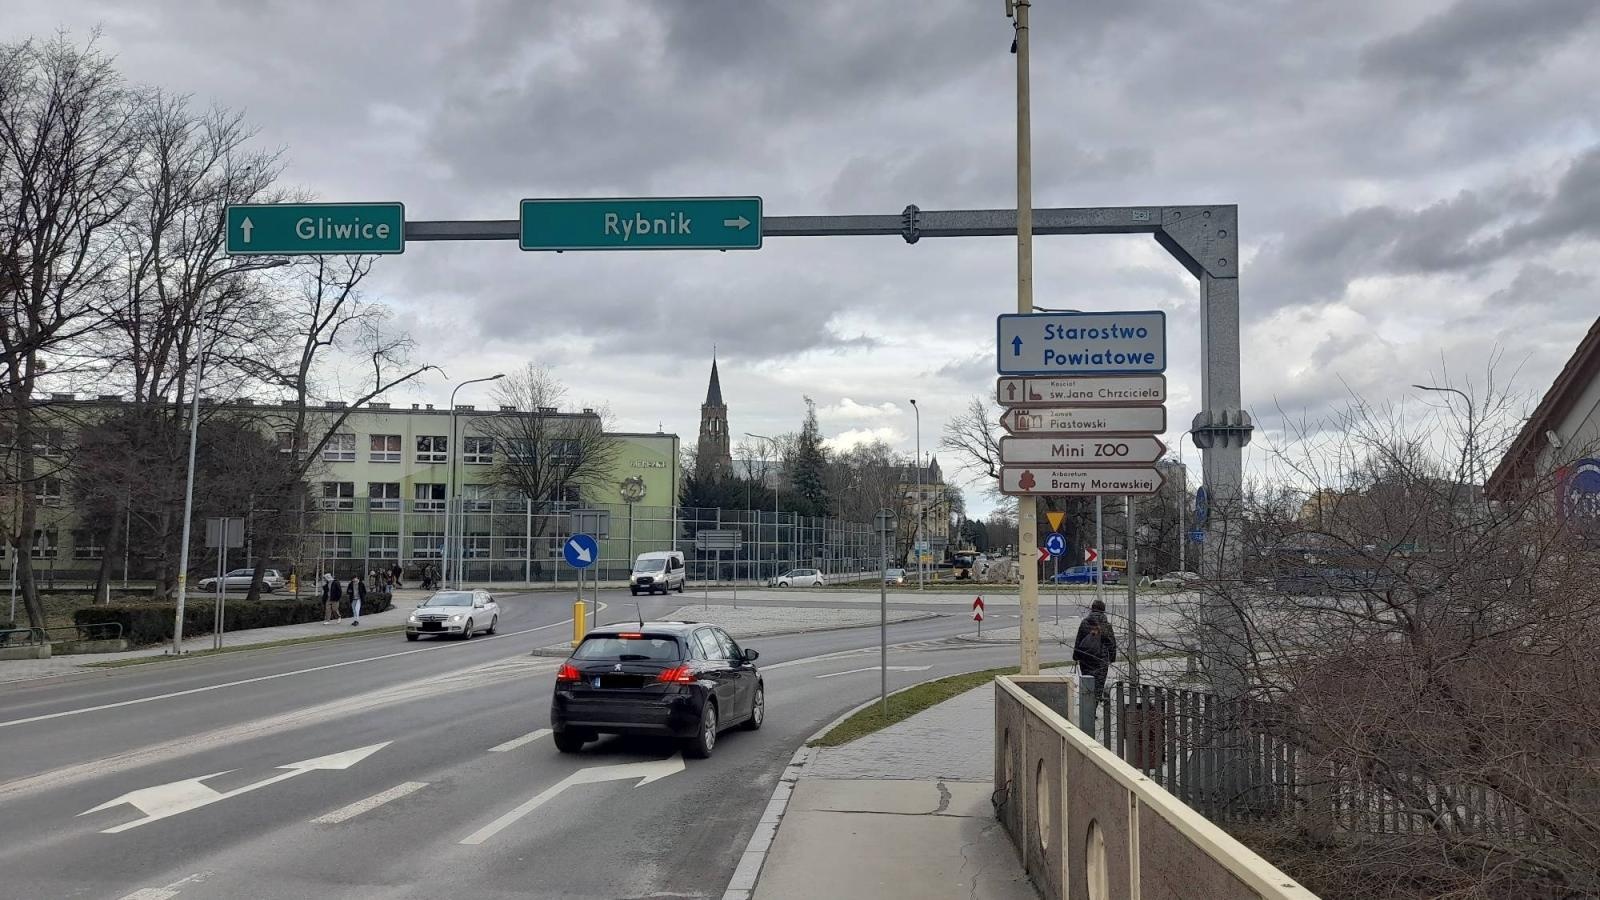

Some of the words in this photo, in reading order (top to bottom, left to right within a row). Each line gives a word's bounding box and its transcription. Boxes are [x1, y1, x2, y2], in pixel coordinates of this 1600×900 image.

[295, 217, 390, 239] Gliwice
[604, 212, 692, 241] Rybnik
[1044, 323, 1148, 340] Starostwo
[1044, 349, 1155, 366] Powiatowe
[1098, 388, 1160, 398] Chrzciciela
[1050, 420, 1107, 428] Piastowski
[1051, 444, 1085, 457] Mini
[1094, 443, 1129, 457] ZOO
[1051, 480, 1086, 491] Bramy
[1091, 480, 1153, 491] Morawskiej
